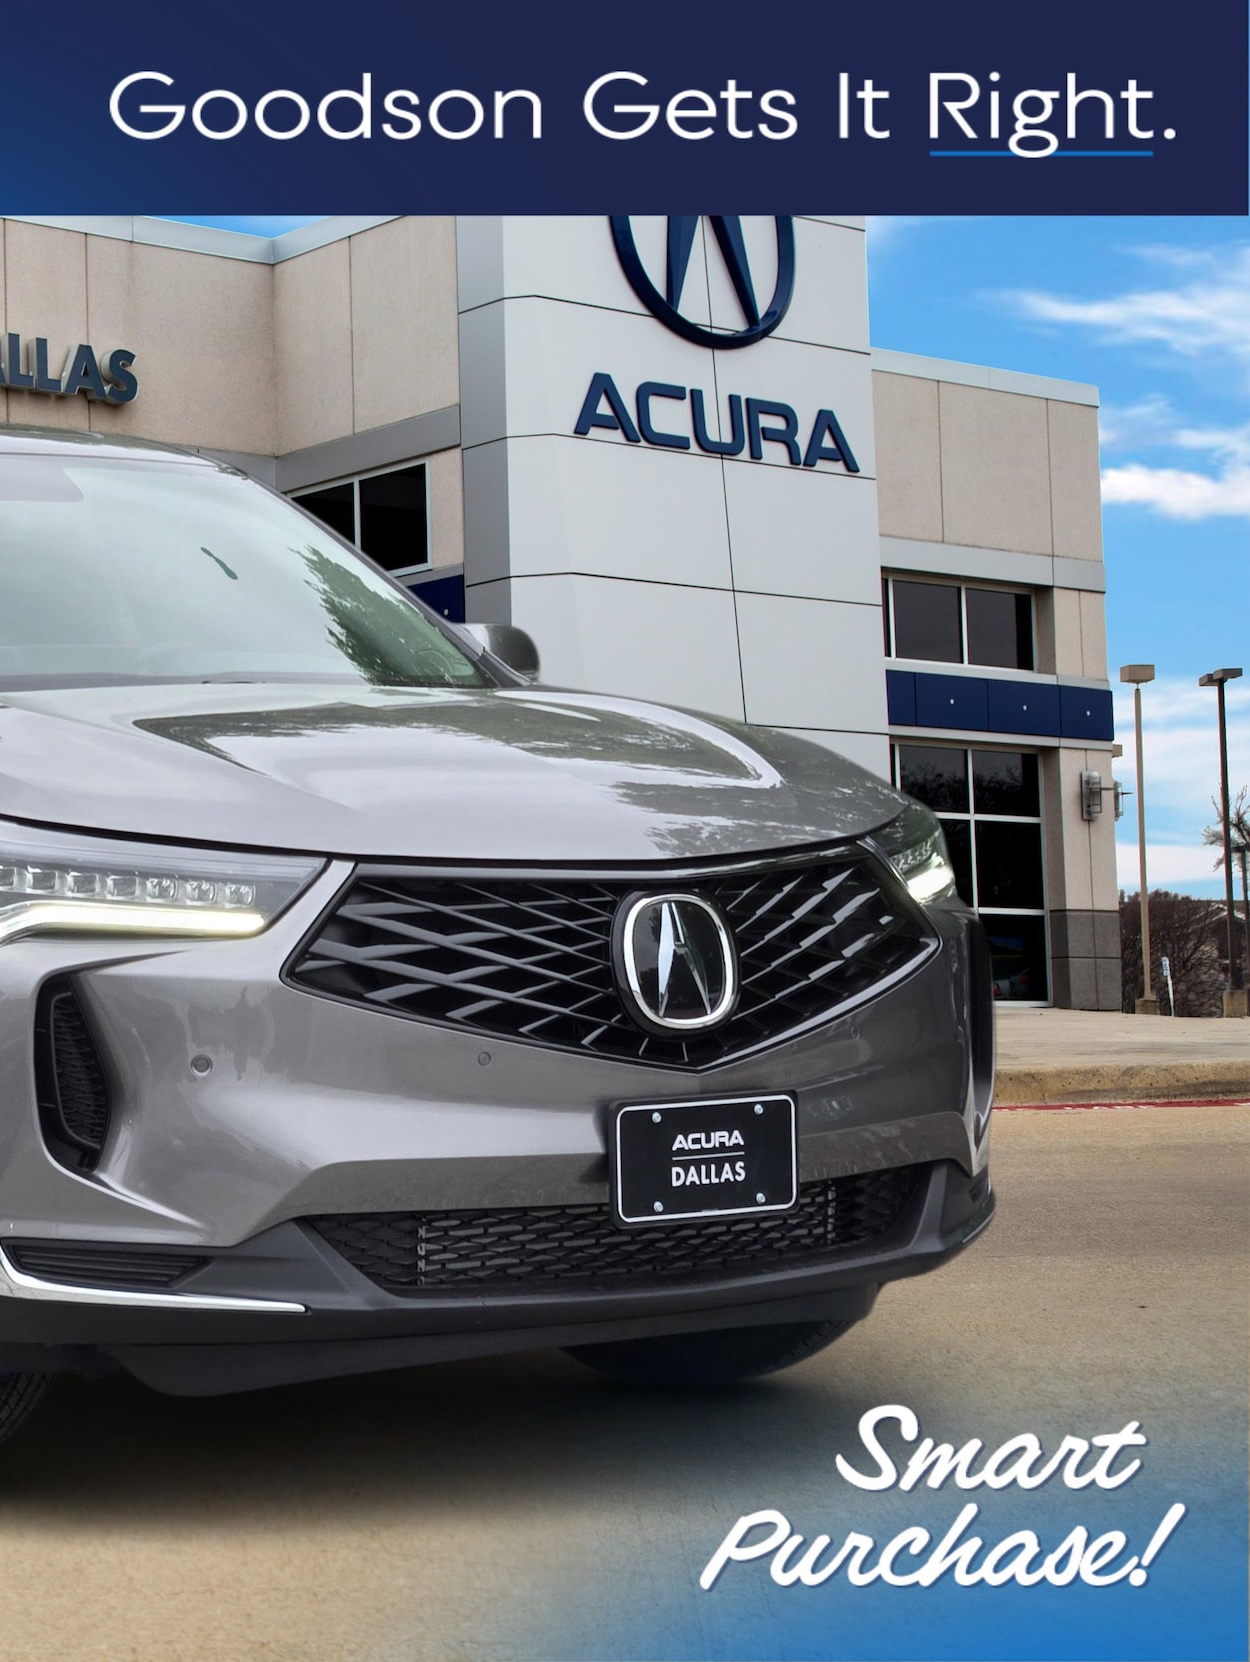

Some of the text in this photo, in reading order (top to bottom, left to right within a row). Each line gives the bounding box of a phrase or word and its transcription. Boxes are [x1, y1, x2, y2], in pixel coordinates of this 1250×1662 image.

[574, 372, 860, 473] ACURA
[672, 1130, 745, 1151] ACURA
[671, 1161, 746, 1187] DALLAS
